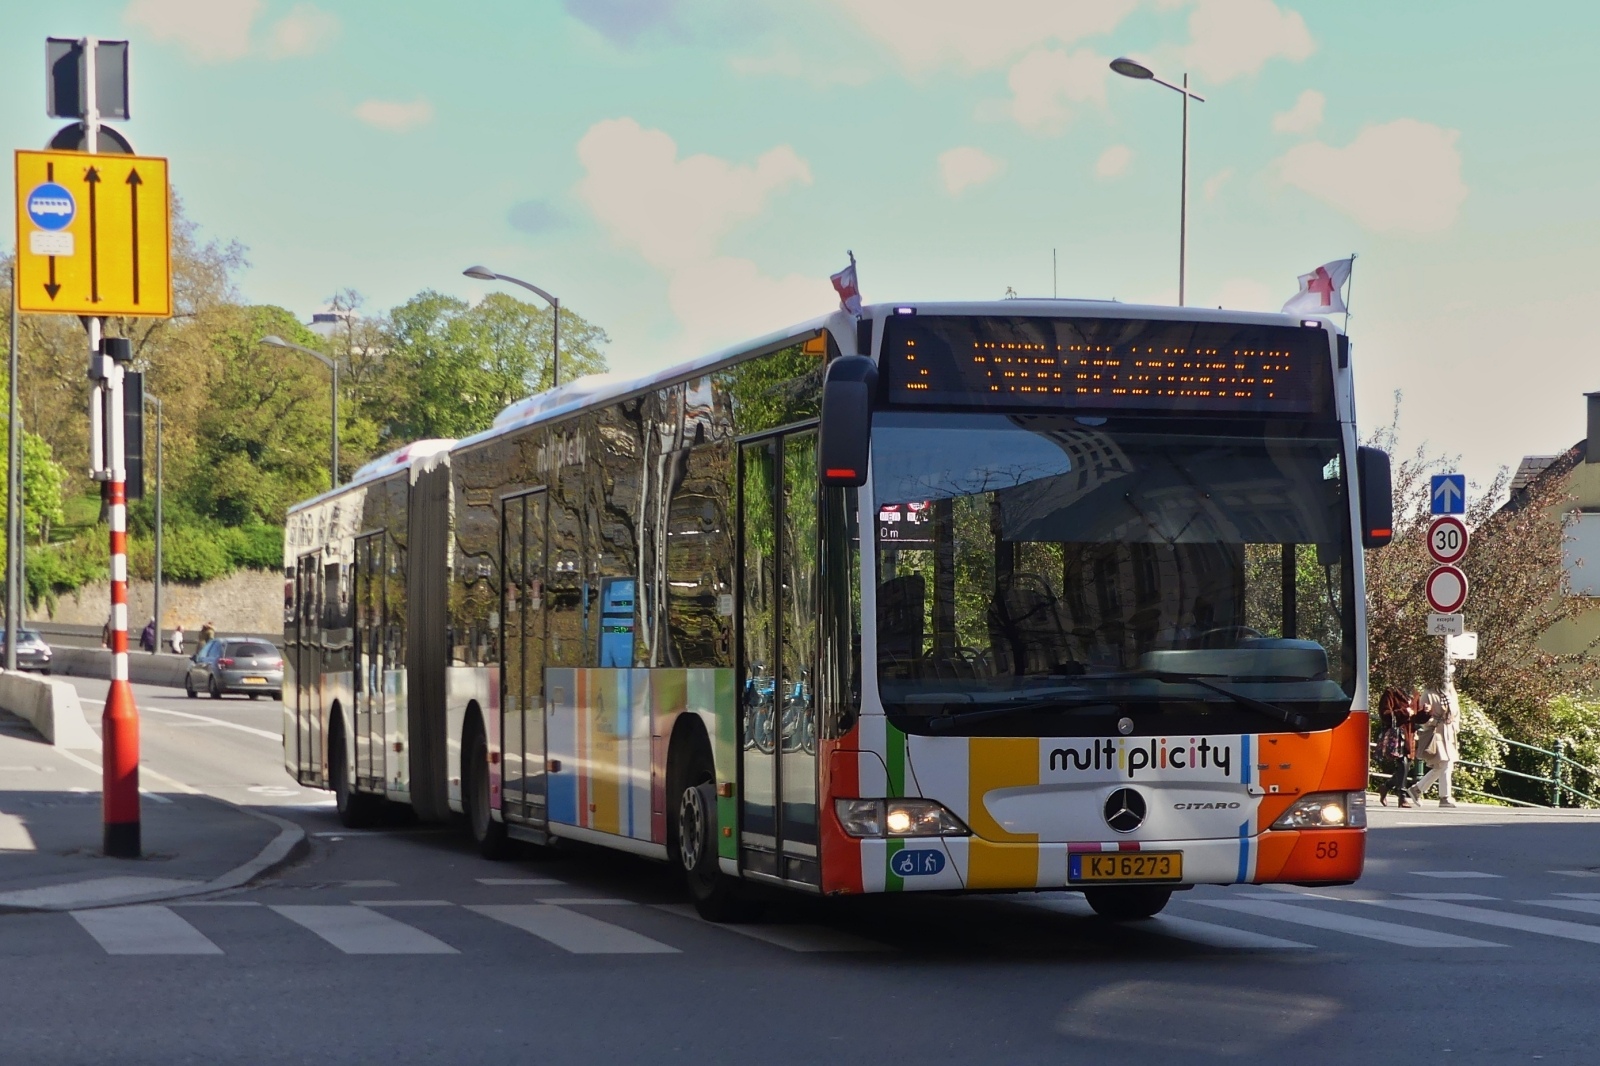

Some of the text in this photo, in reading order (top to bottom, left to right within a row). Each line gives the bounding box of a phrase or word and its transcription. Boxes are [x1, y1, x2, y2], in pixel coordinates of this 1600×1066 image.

[890, 530, 899, 538] m
[1436, 530, 1458, 550] 30
[1049, 737, 1231, 779] multiplicity
[1173, 802, 1241, 811] CITARO
[1315, 840, 1339, 860] 58
